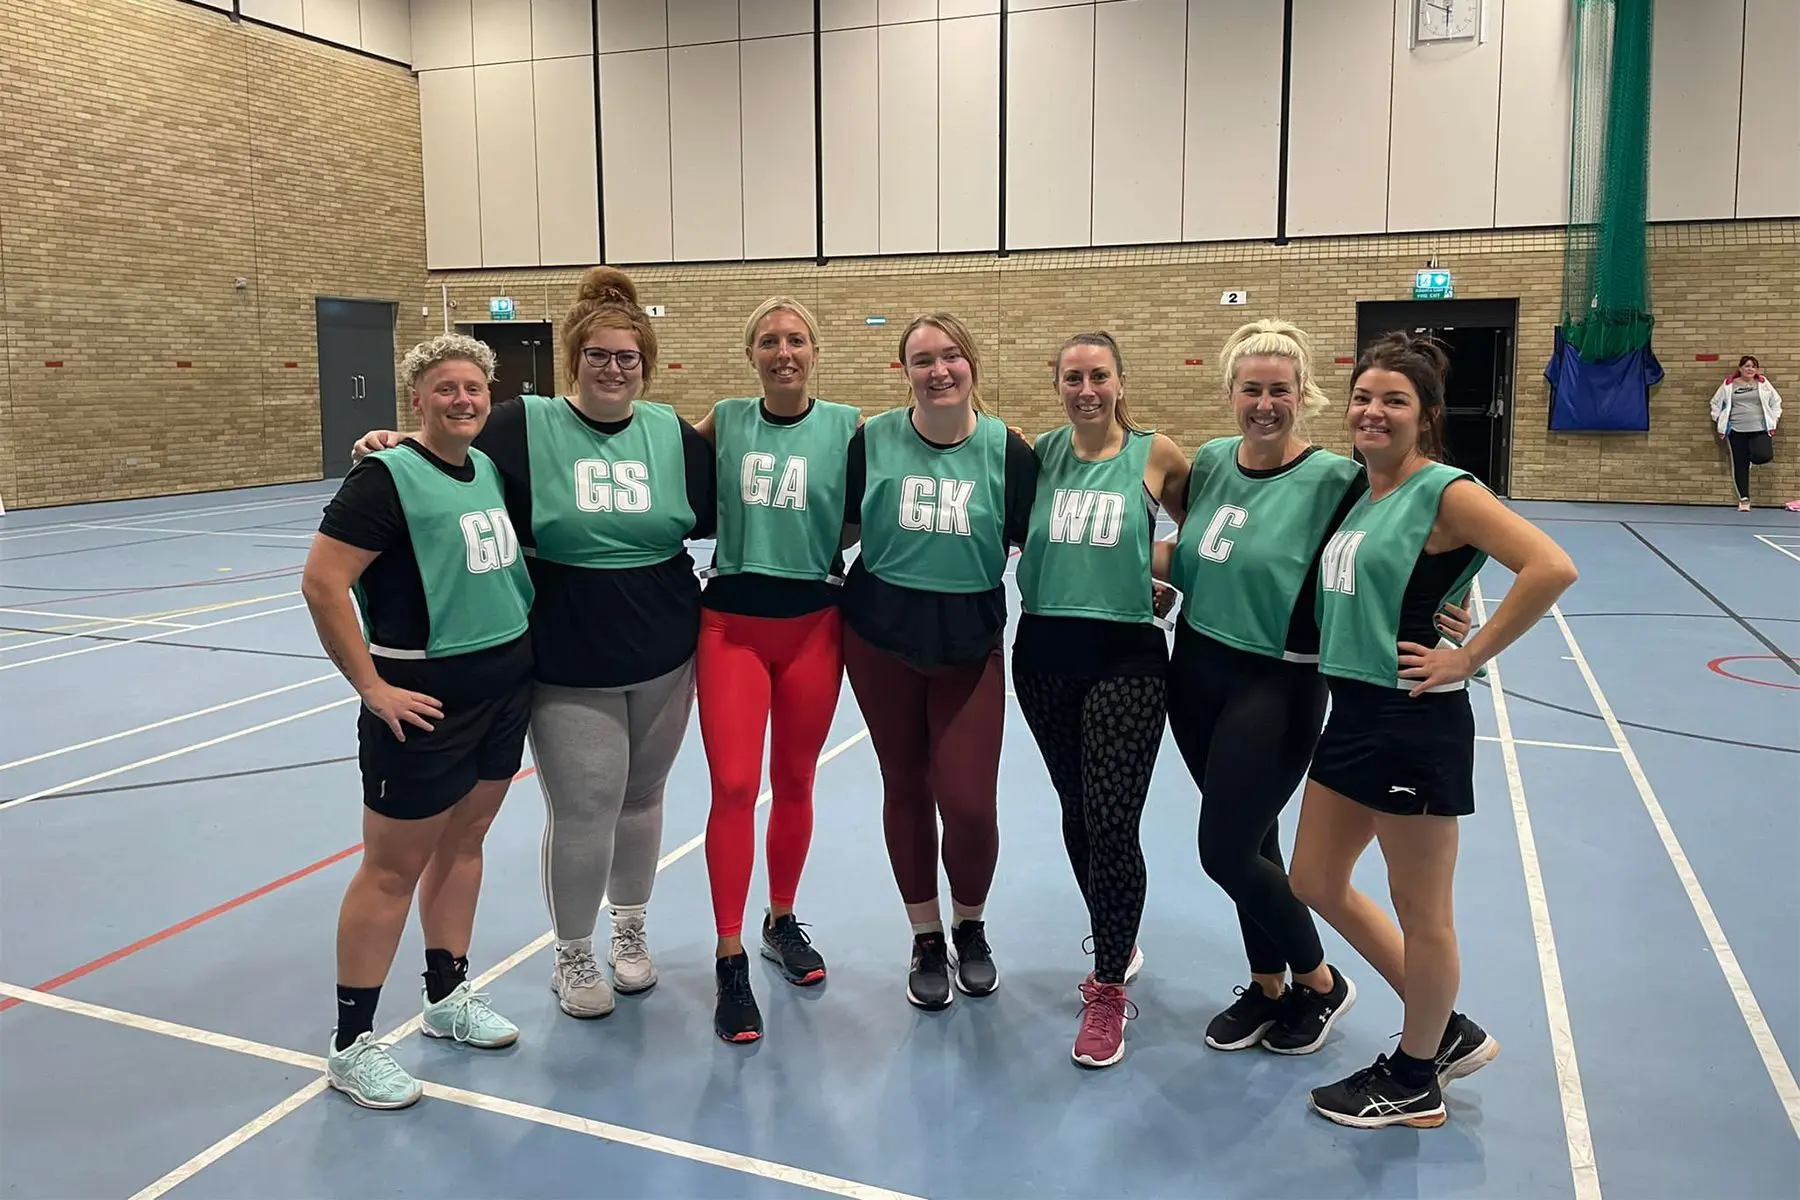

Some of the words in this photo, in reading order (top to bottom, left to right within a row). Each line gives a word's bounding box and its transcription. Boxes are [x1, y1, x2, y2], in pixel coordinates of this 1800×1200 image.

[651, 306, 657, 316] 1
[1228, 292, 1238, 304] 2
[574, 458, 652, 513] GS
[740, 451, 808, 511] GA
[899, 475, 976, 536] GK
[460, 508, 518, 574] GD
[1049, 488, 1126, 547] WD
[1197, 504, 1249, 564] C
